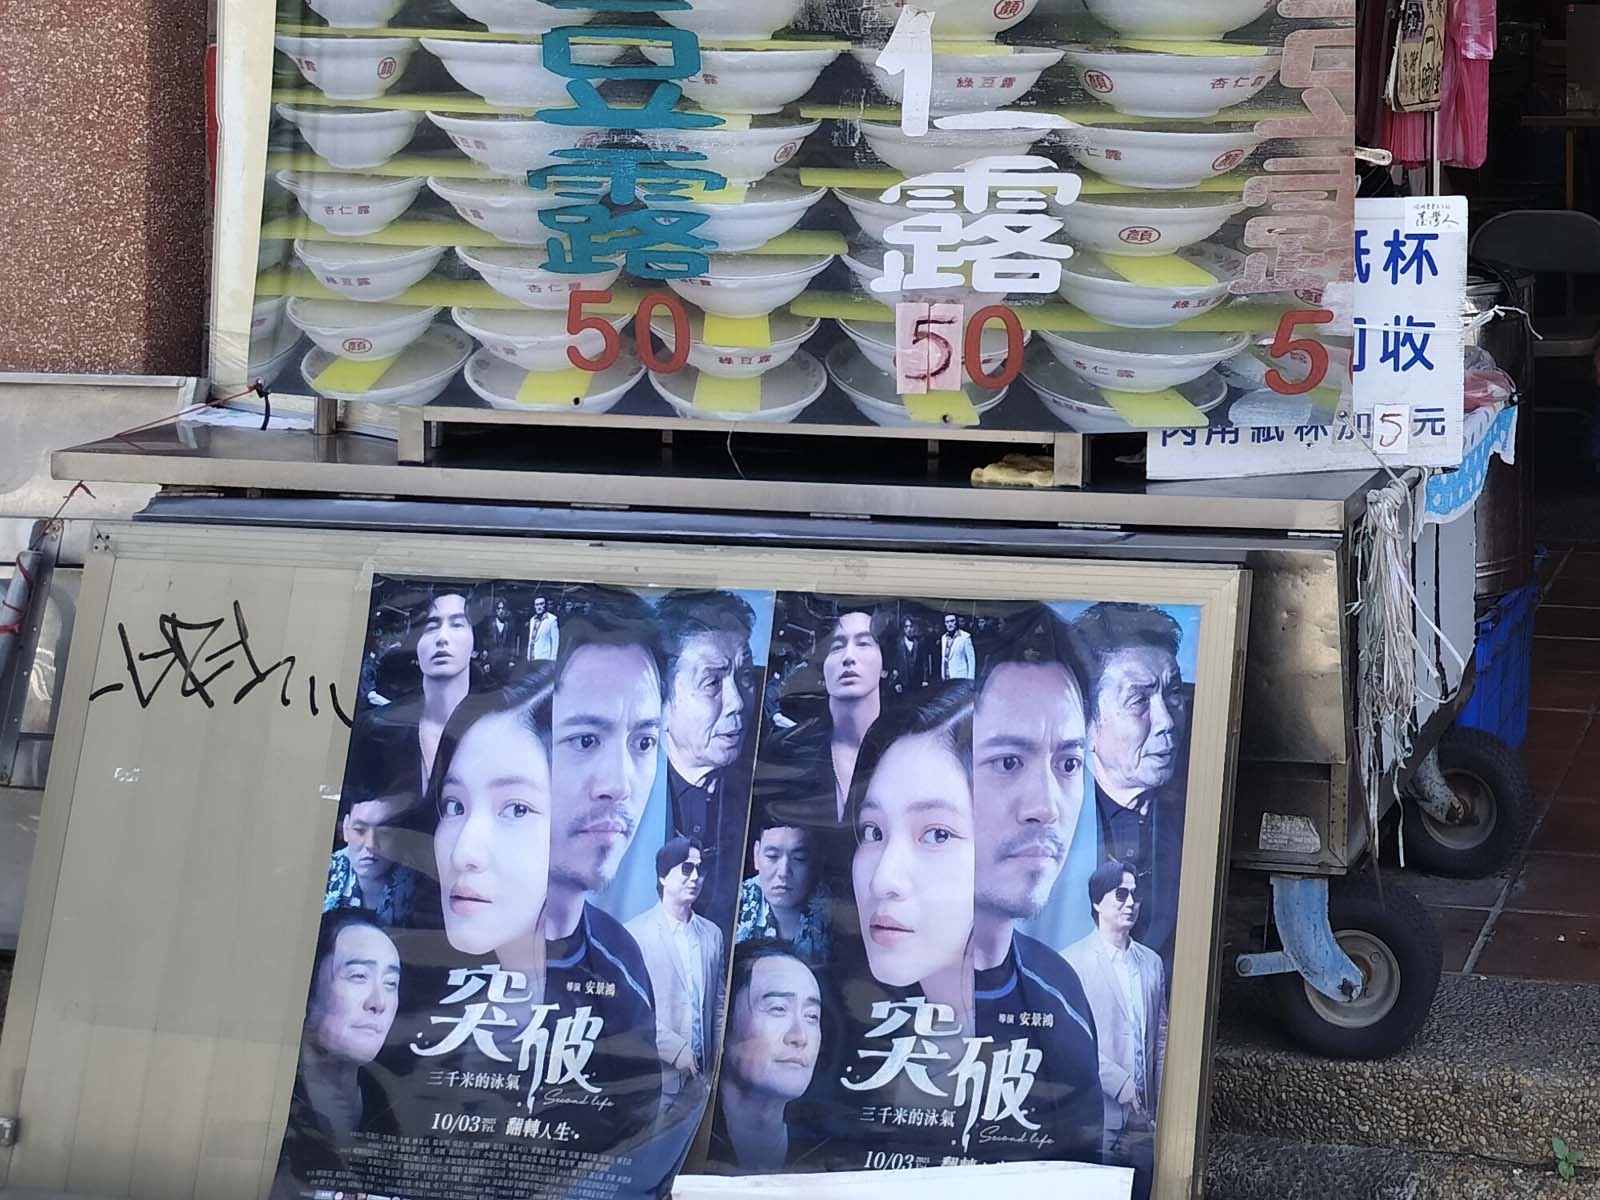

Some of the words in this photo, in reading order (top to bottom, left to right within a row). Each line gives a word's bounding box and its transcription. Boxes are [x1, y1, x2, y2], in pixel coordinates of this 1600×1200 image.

[566, 290, 691, 375] 50
[902, 304, 1025, 391] 50
[1265, 310, 1354, 396] 5
[410, 964, 604, 1114] 突破
[427, 1070, 520, 1092] 三千米的泳氣
[840, 996, 1043, 1153] 突破
[432, 1112, 481, 1134] 10/03
[859, 1106, 956, 1129] 三千米的泳氣
